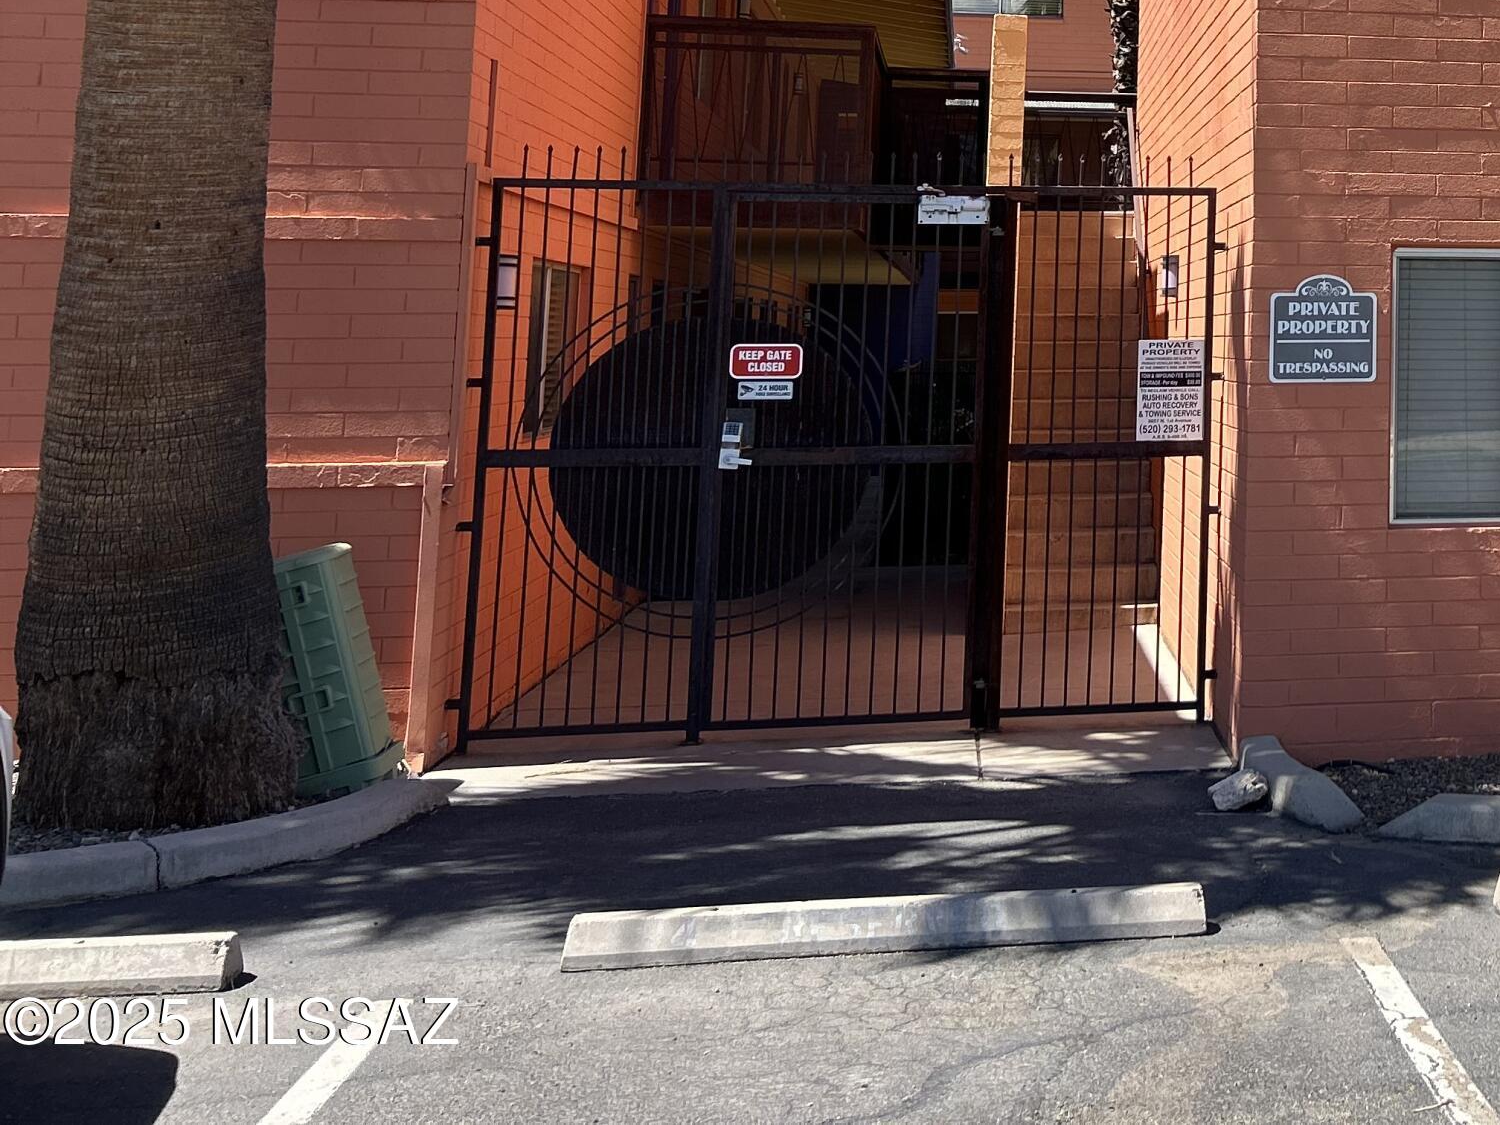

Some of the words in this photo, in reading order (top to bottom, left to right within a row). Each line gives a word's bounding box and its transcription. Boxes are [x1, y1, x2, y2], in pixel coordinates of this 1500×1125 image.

[1288, 301, 1360, 316] PRIVATE
[1277, 320, 1370, 334] PROPERTY
[738, 350, 765, 361] KEEP
[766, 350, 792, 361] GATE
[1313, 348, 1333, 359] NO
[747, 362, 785, 372] CLOSED
[1277, 362, 1369, 374] TRESPASSING
[1140, 425, 1161, 434] (520)
[1163, 424, 1200, 434] 293-1781
